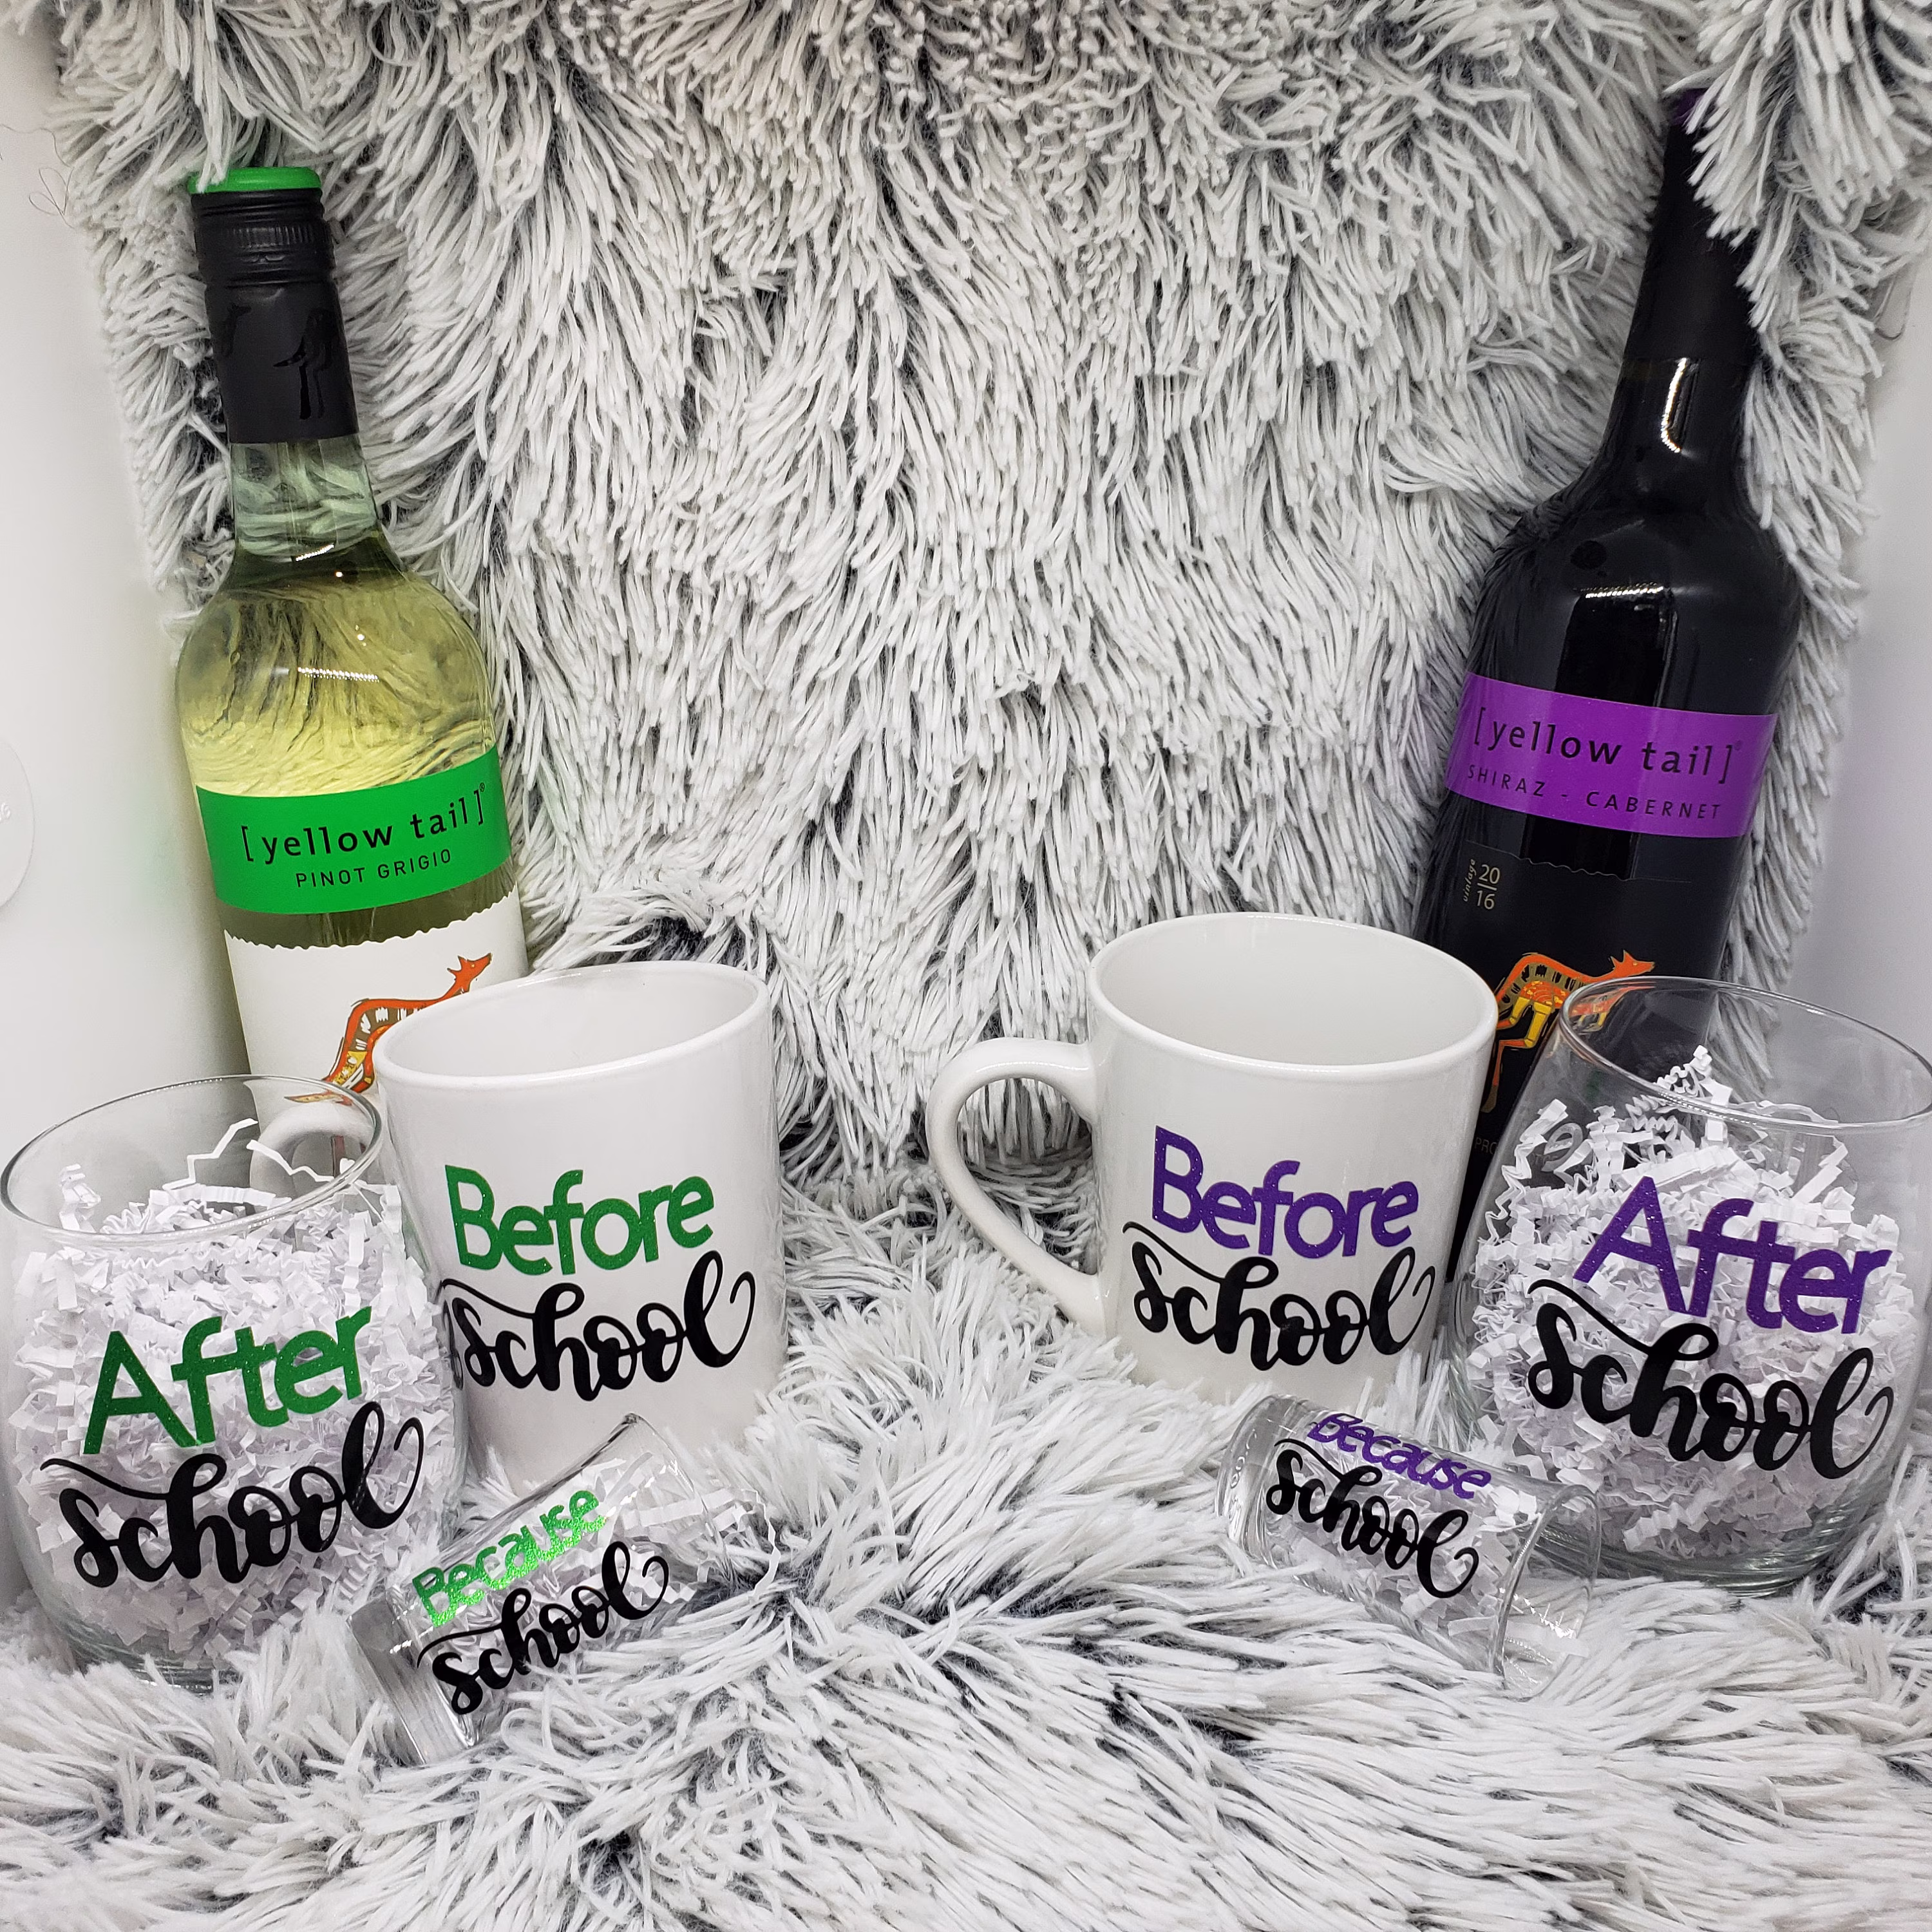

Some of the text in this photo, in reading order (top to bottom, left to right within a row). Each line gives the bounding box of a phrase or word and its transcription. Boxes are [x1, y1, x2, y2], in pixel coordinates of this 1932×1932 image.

[1468, 764, 1546, 797] SHIRAZ
[1586, 791, 1722, 820] CABERNET
[296, 848, 451, 887] PINOT GRIGIO
[1477, 890, 1495, 910] 16
[1479, 864, 1501, 884] 20
[445, 1164, 714, 1276] Before
[1152, 1125, 1419, 1259] Before
[1573, 1176, 1892, 1334] After
[1122, 1221, 1435, 1371] school
[83, 1306, 372, 1455] After
[1528, 1278, 1894, 1480] school
[40, 1401, 424, 1587] school
[1265, 1438, 1479, 1599] school
[1307, 1412, 1492, 1499] Because
[412, 1490, 607, 1627] Because
